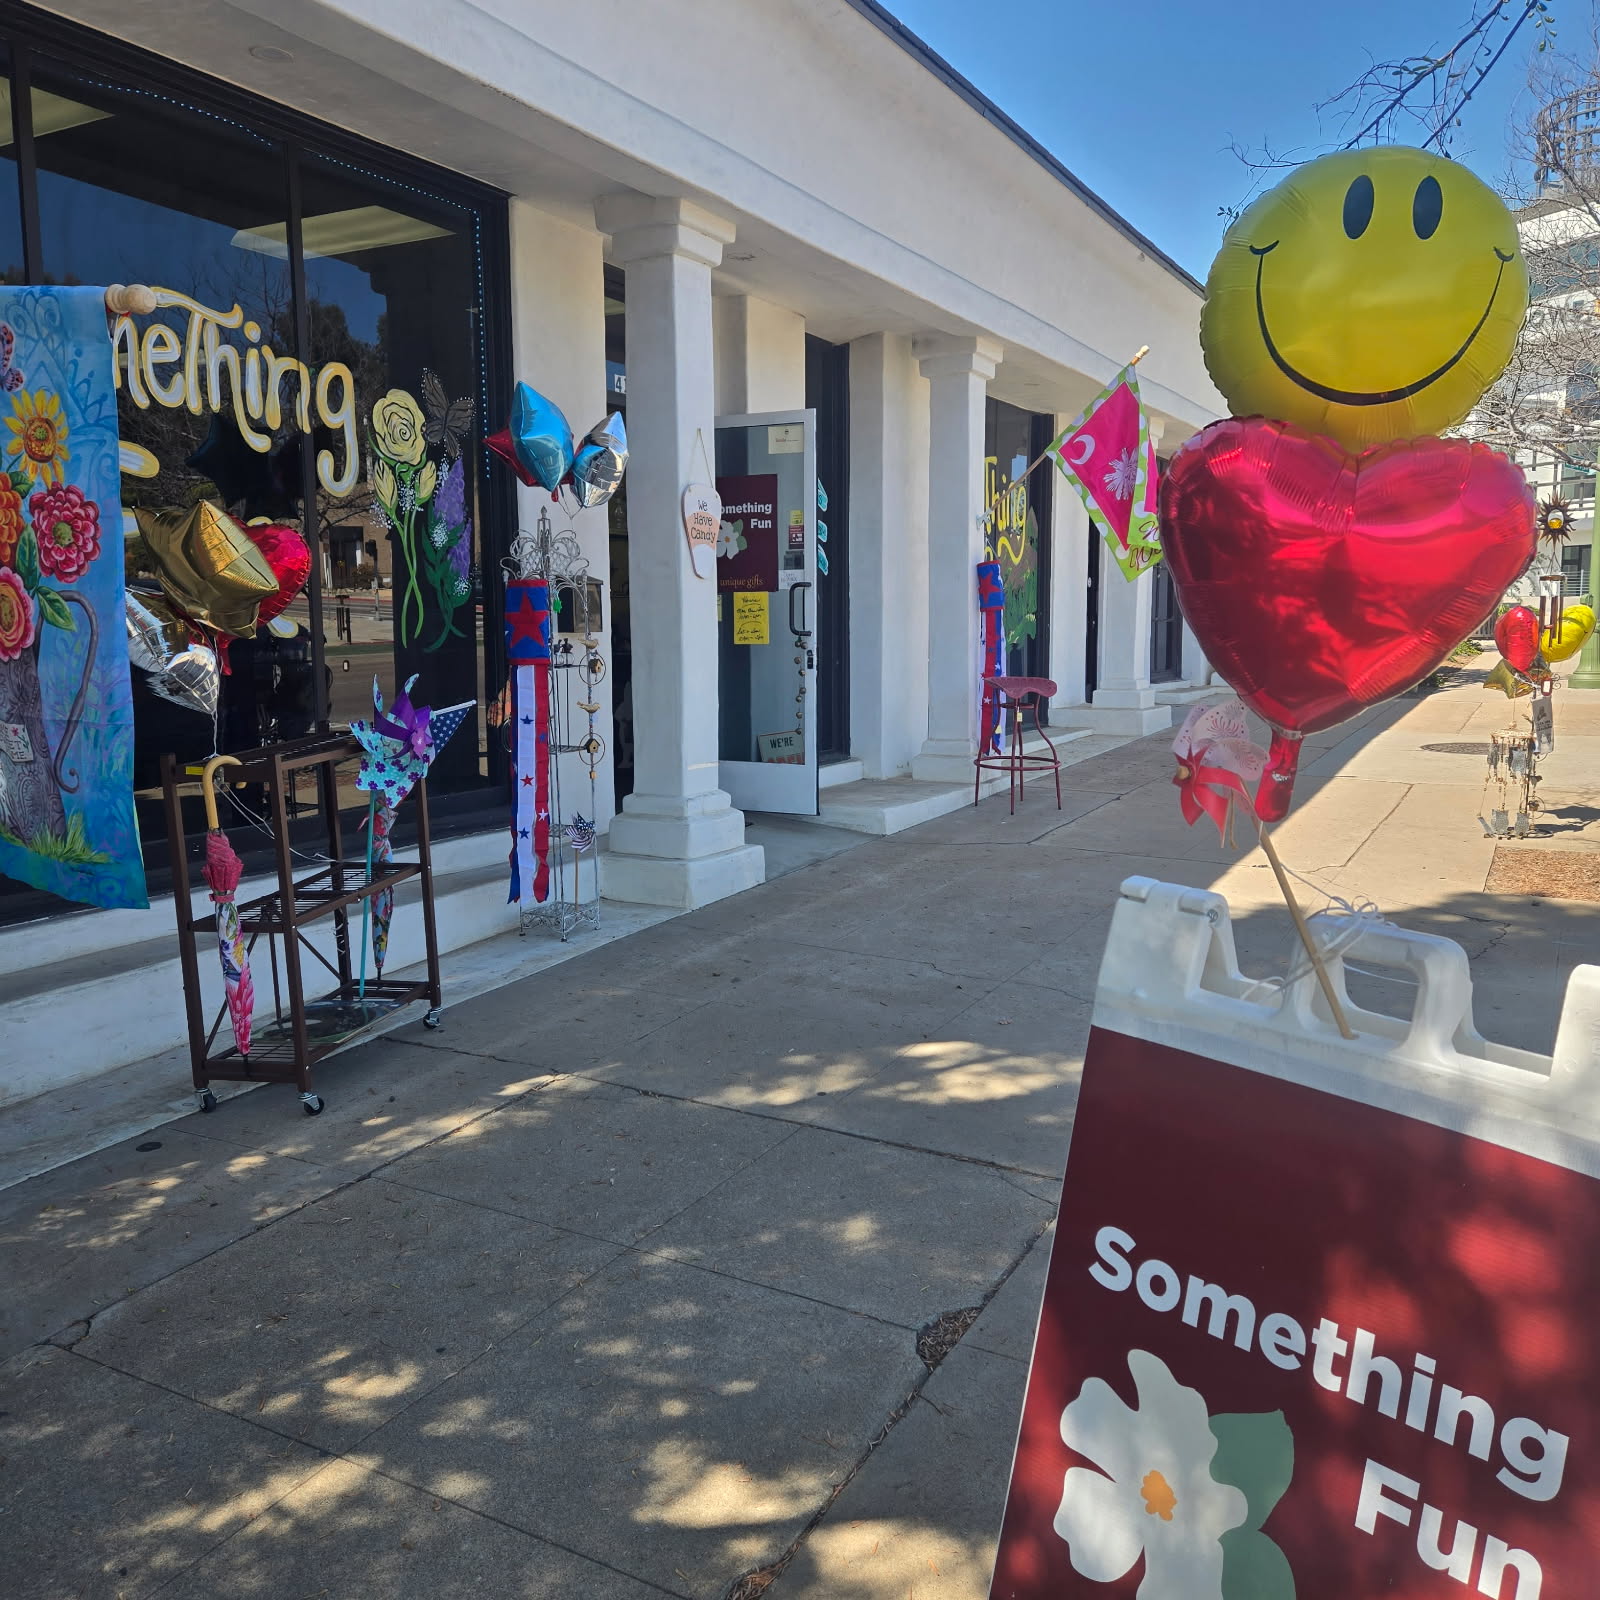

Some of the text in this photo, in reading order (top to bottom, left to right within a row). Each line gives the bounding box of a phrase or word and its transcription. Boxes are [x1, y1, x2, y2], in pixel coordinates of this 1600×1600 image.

[615, 376, 627, 393] 4
[697, 499, 708, 512] We
[720, 502, 772, 515] omething
[693, 512, 713, 527] Have
[750, 518, 772, 529] Fun
[690, 527, 716, 544] Candy
[720, 574, 764, 589] unique gifts
[769, 736, 794, 749] WE'RE
[1088, 1226, 1570, 1502] Something
[1355, 1458, 1543, 1600] Fun
